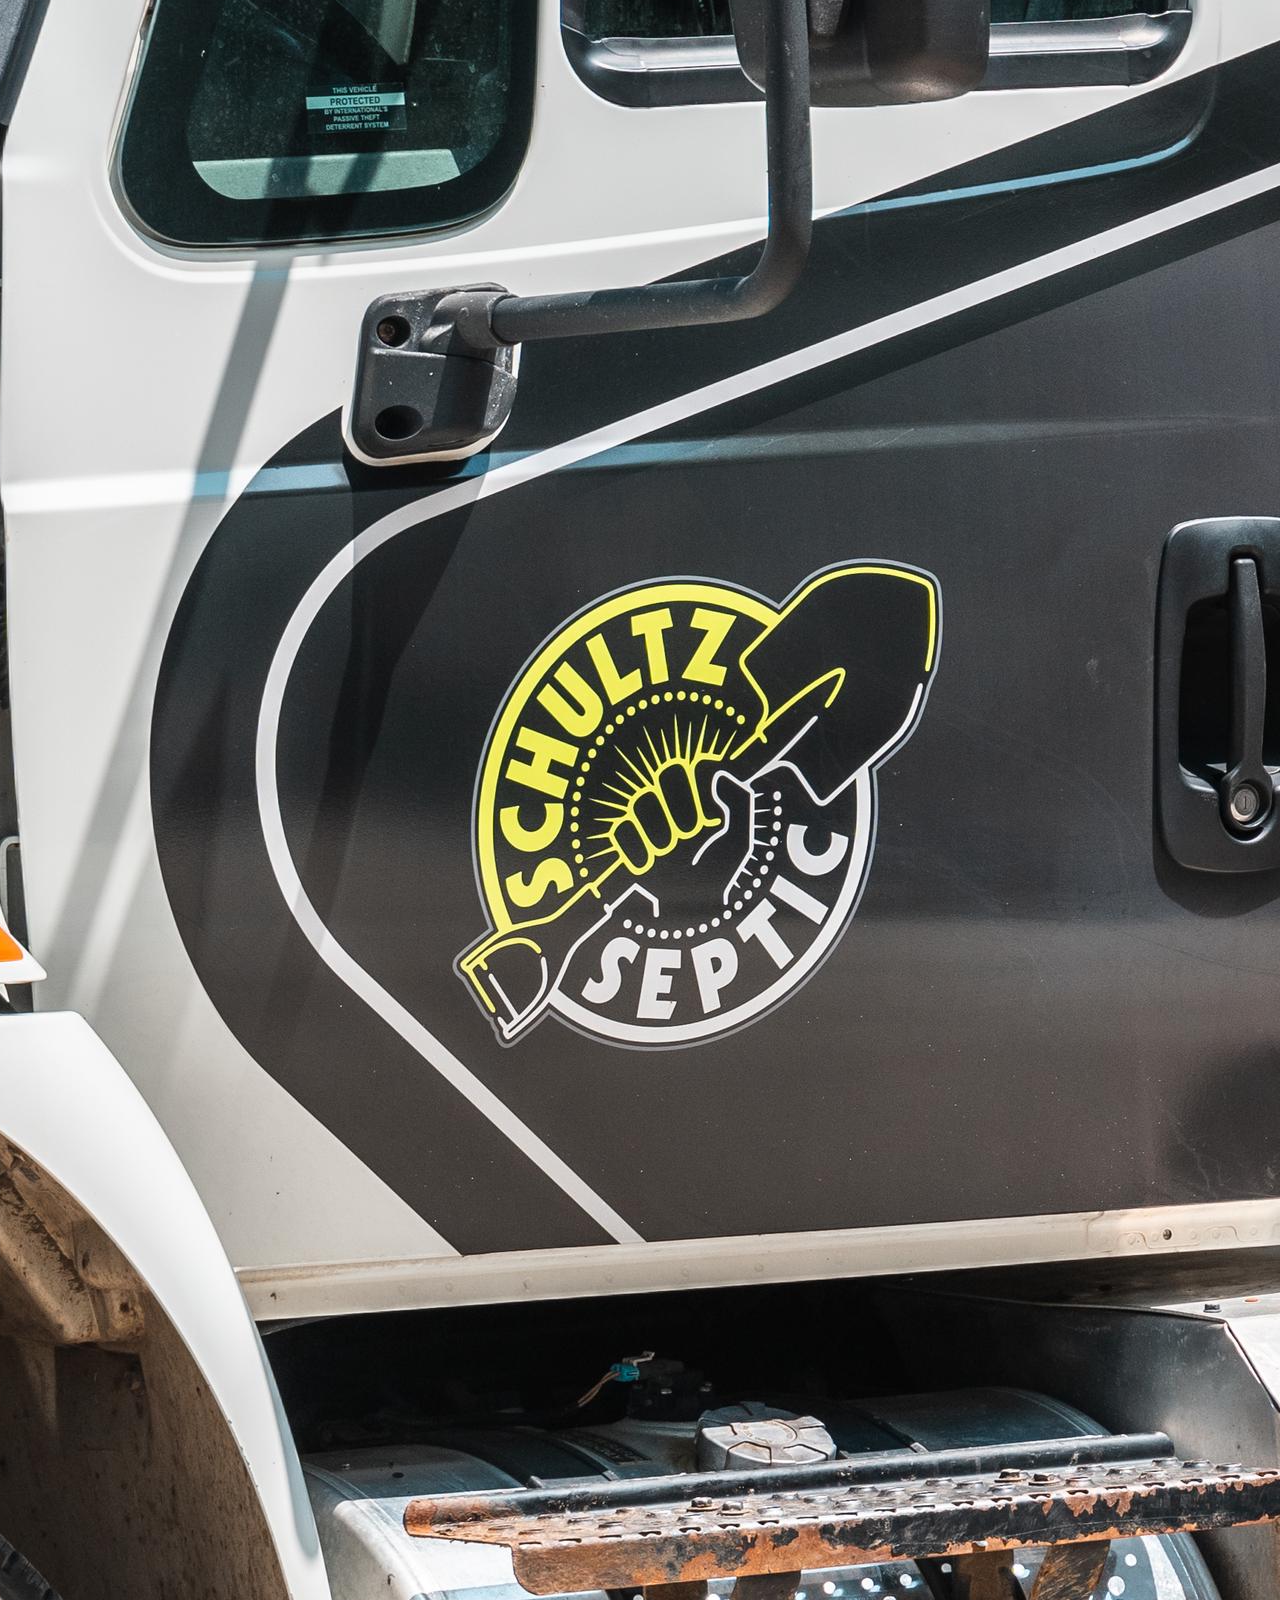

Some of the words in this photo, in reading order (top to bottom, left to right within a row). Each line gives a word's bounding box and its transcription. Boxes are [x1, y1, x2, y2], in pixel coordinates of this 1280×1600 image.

[349, 84, 377, 93] VEHICLE
[330, 96, 381, 106] PROTECTED
[334, 106, 389, 114] INTERNATIONAL'S
[333, 114, 359, 122] PASSIVE
[325, 122, 362, 131] DETERRENT
[363, 121, 389, 129] SYSTEM
[500, 608, 737, 908] SCHULTZ
[581, 824, 850, 1019] SEPTIC
